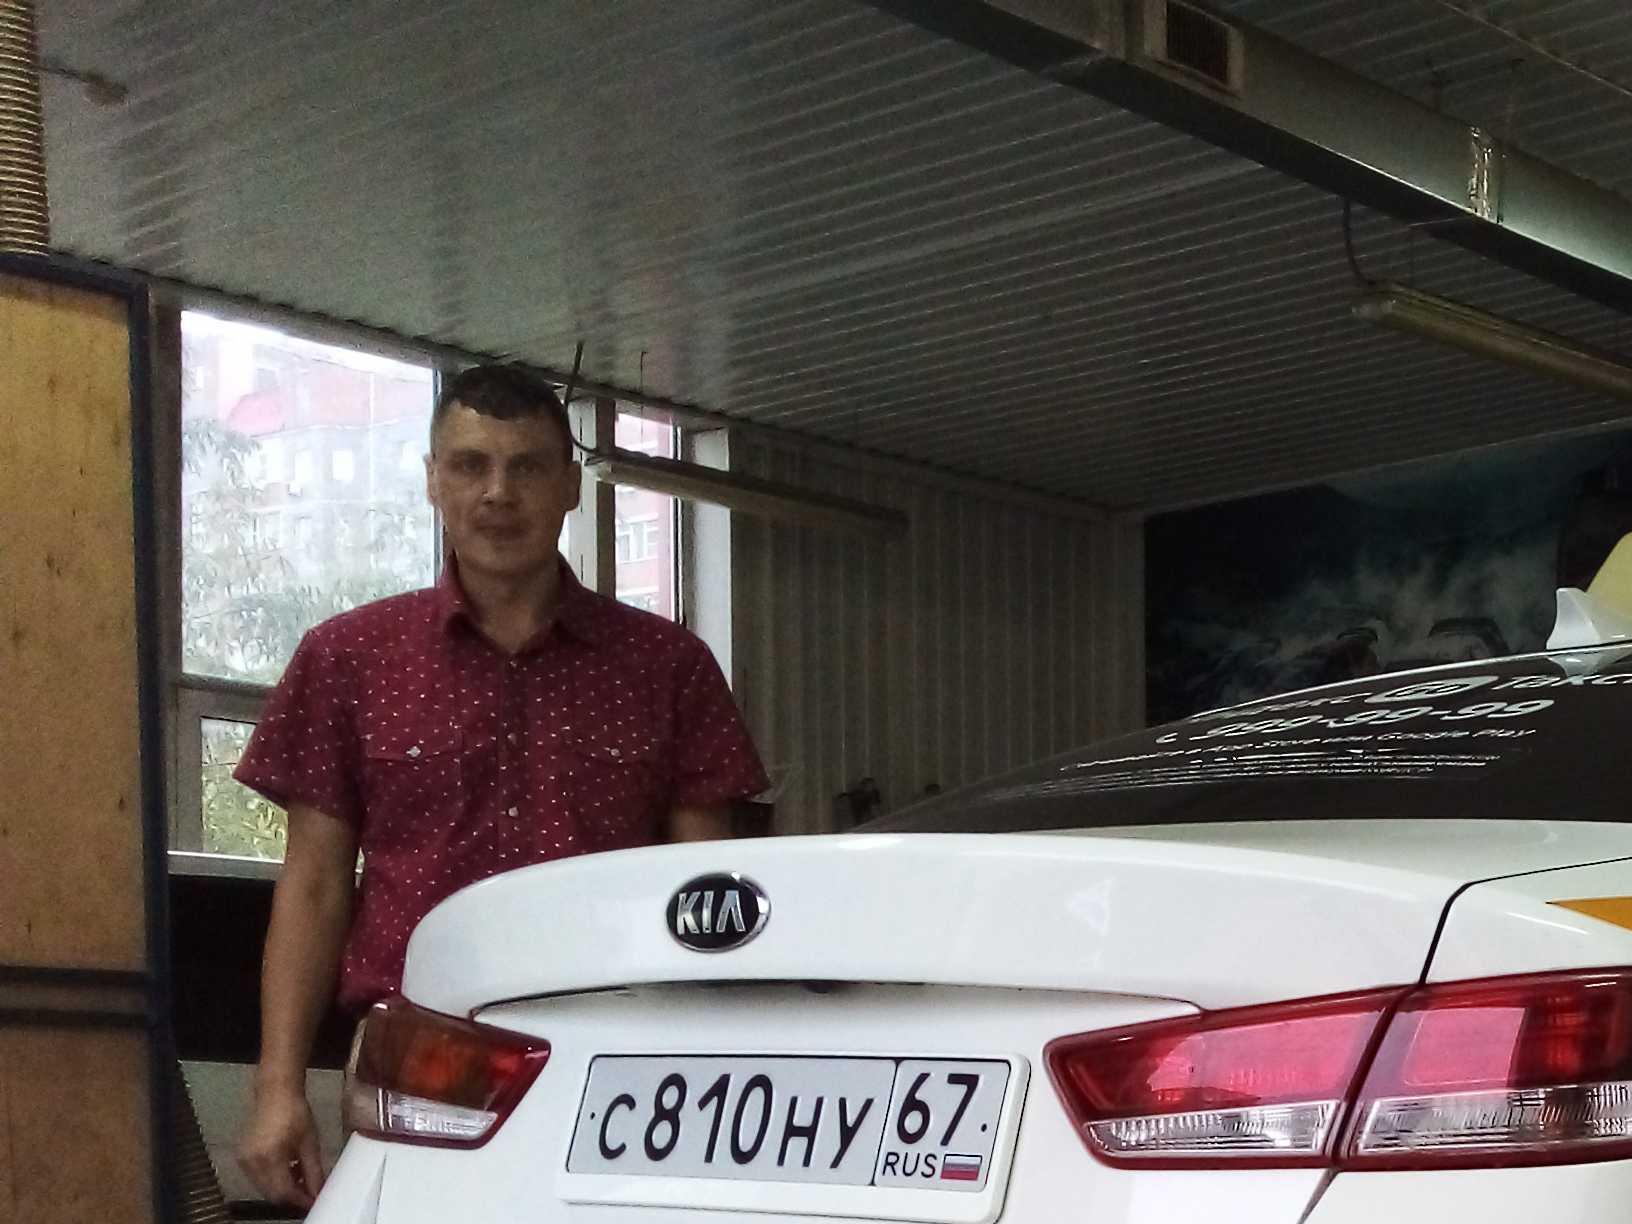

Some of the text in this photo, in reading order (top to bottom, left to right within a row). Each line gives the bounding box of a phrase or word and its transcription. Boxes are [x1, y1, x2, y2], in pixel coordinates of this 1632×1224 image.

[676, 890, 747, 935] KIA
[896, 1072, 982, 1147] 67
[881, 1151, 938, 1179] RUS
